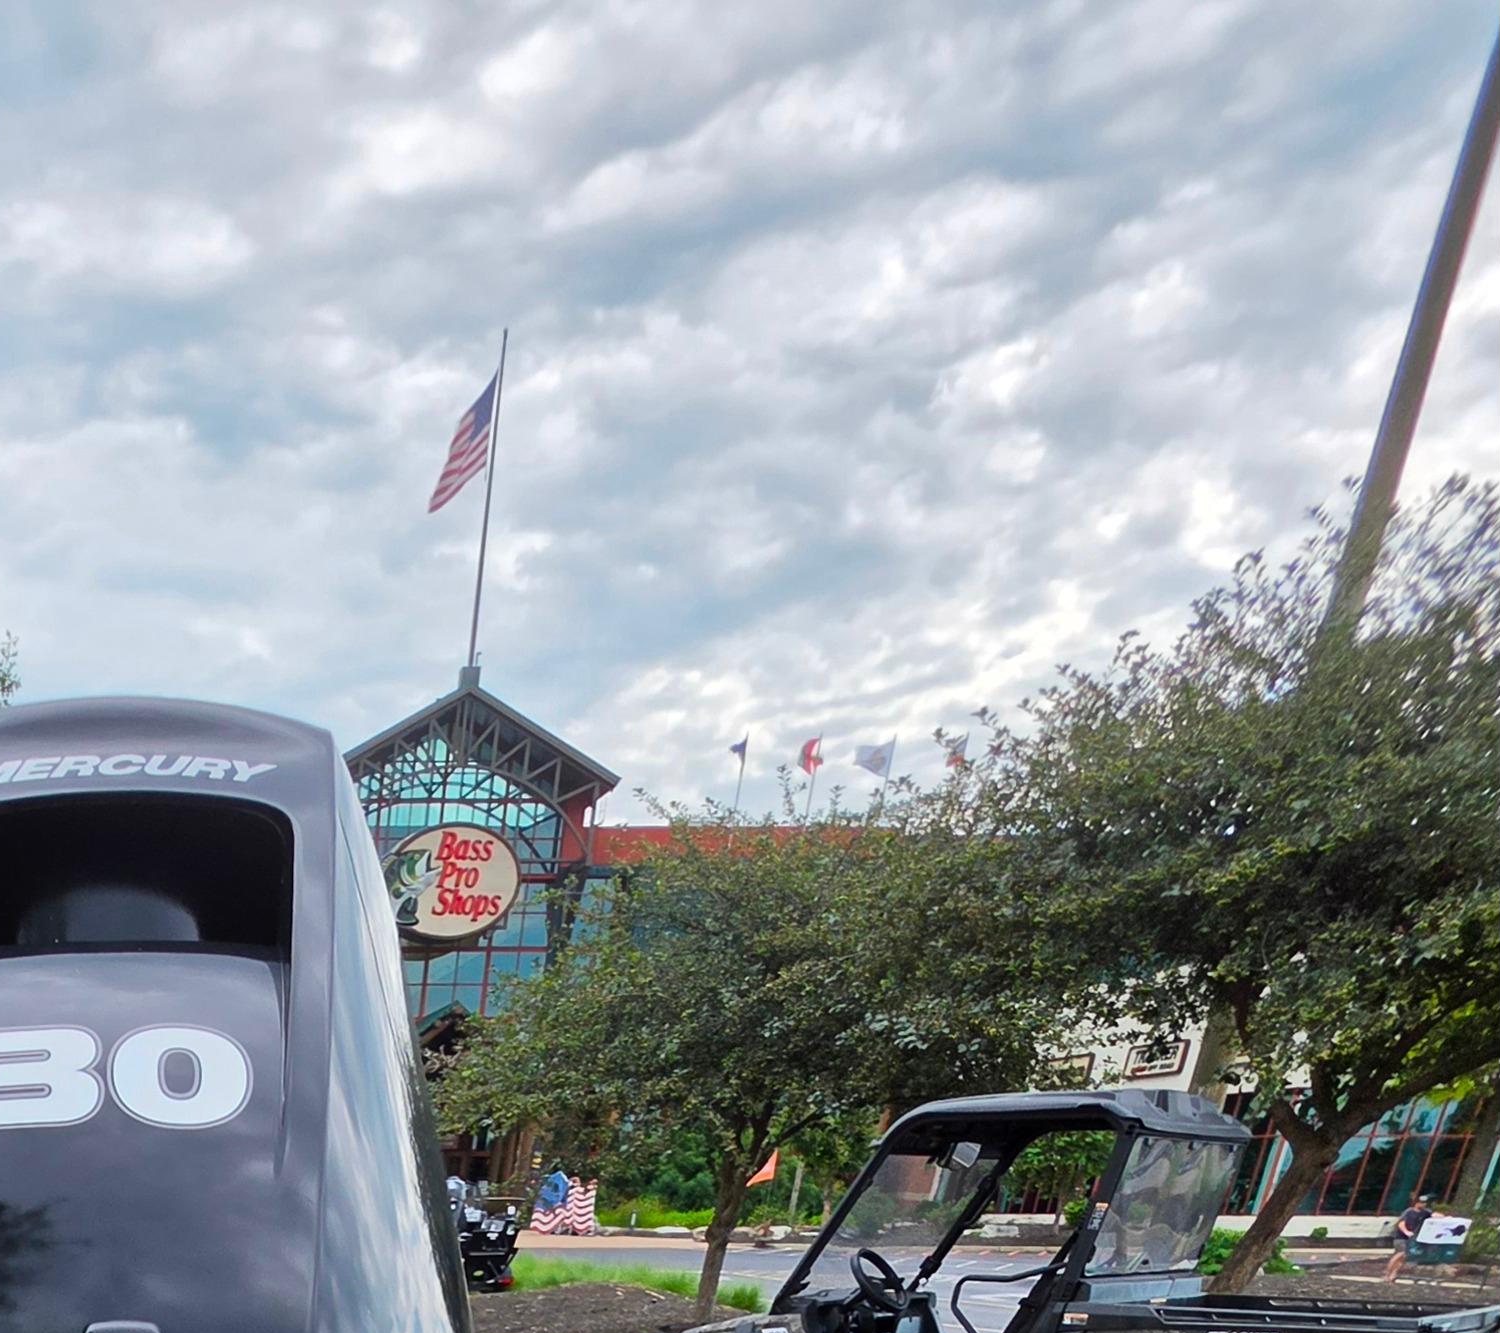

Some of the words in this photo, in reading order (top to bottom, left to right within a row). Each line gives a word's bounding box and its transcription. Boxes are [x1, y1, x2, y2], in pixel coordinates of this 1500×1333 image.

[434, 831, 494, 861] Bass
[435, 860, 480, 889] Pro
[431, 888, 502, 922] Shops
